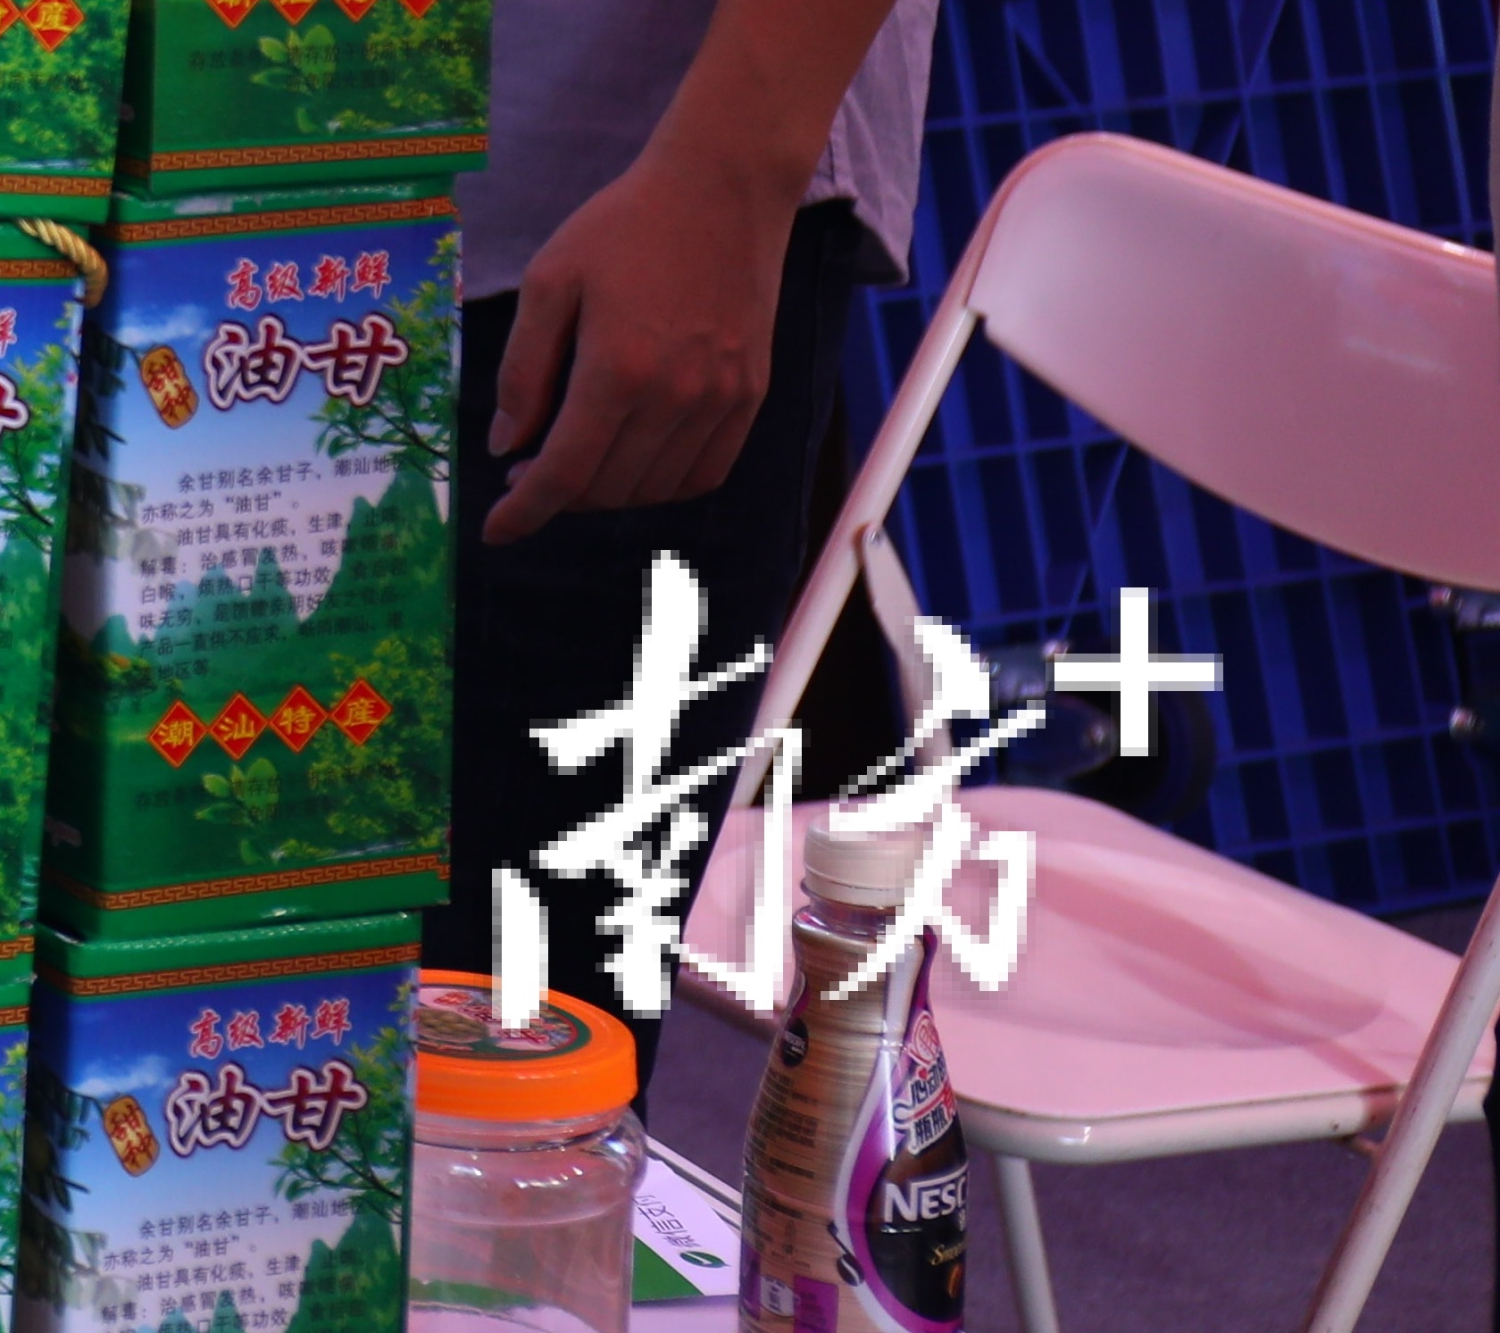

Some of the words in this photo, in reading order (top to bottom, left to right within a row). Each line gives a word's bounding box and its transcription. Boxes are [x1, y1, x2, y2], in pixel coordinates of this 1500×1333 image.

[227, 250, 391, 311] 高级新鲜
[204, 311, 408, 411] 油甘
[187, 997, 353, 1060] 高级新鲜
[166, 1059, 368, 1158] 油甘
[631, 1195, 702, 1247] 微信支付
